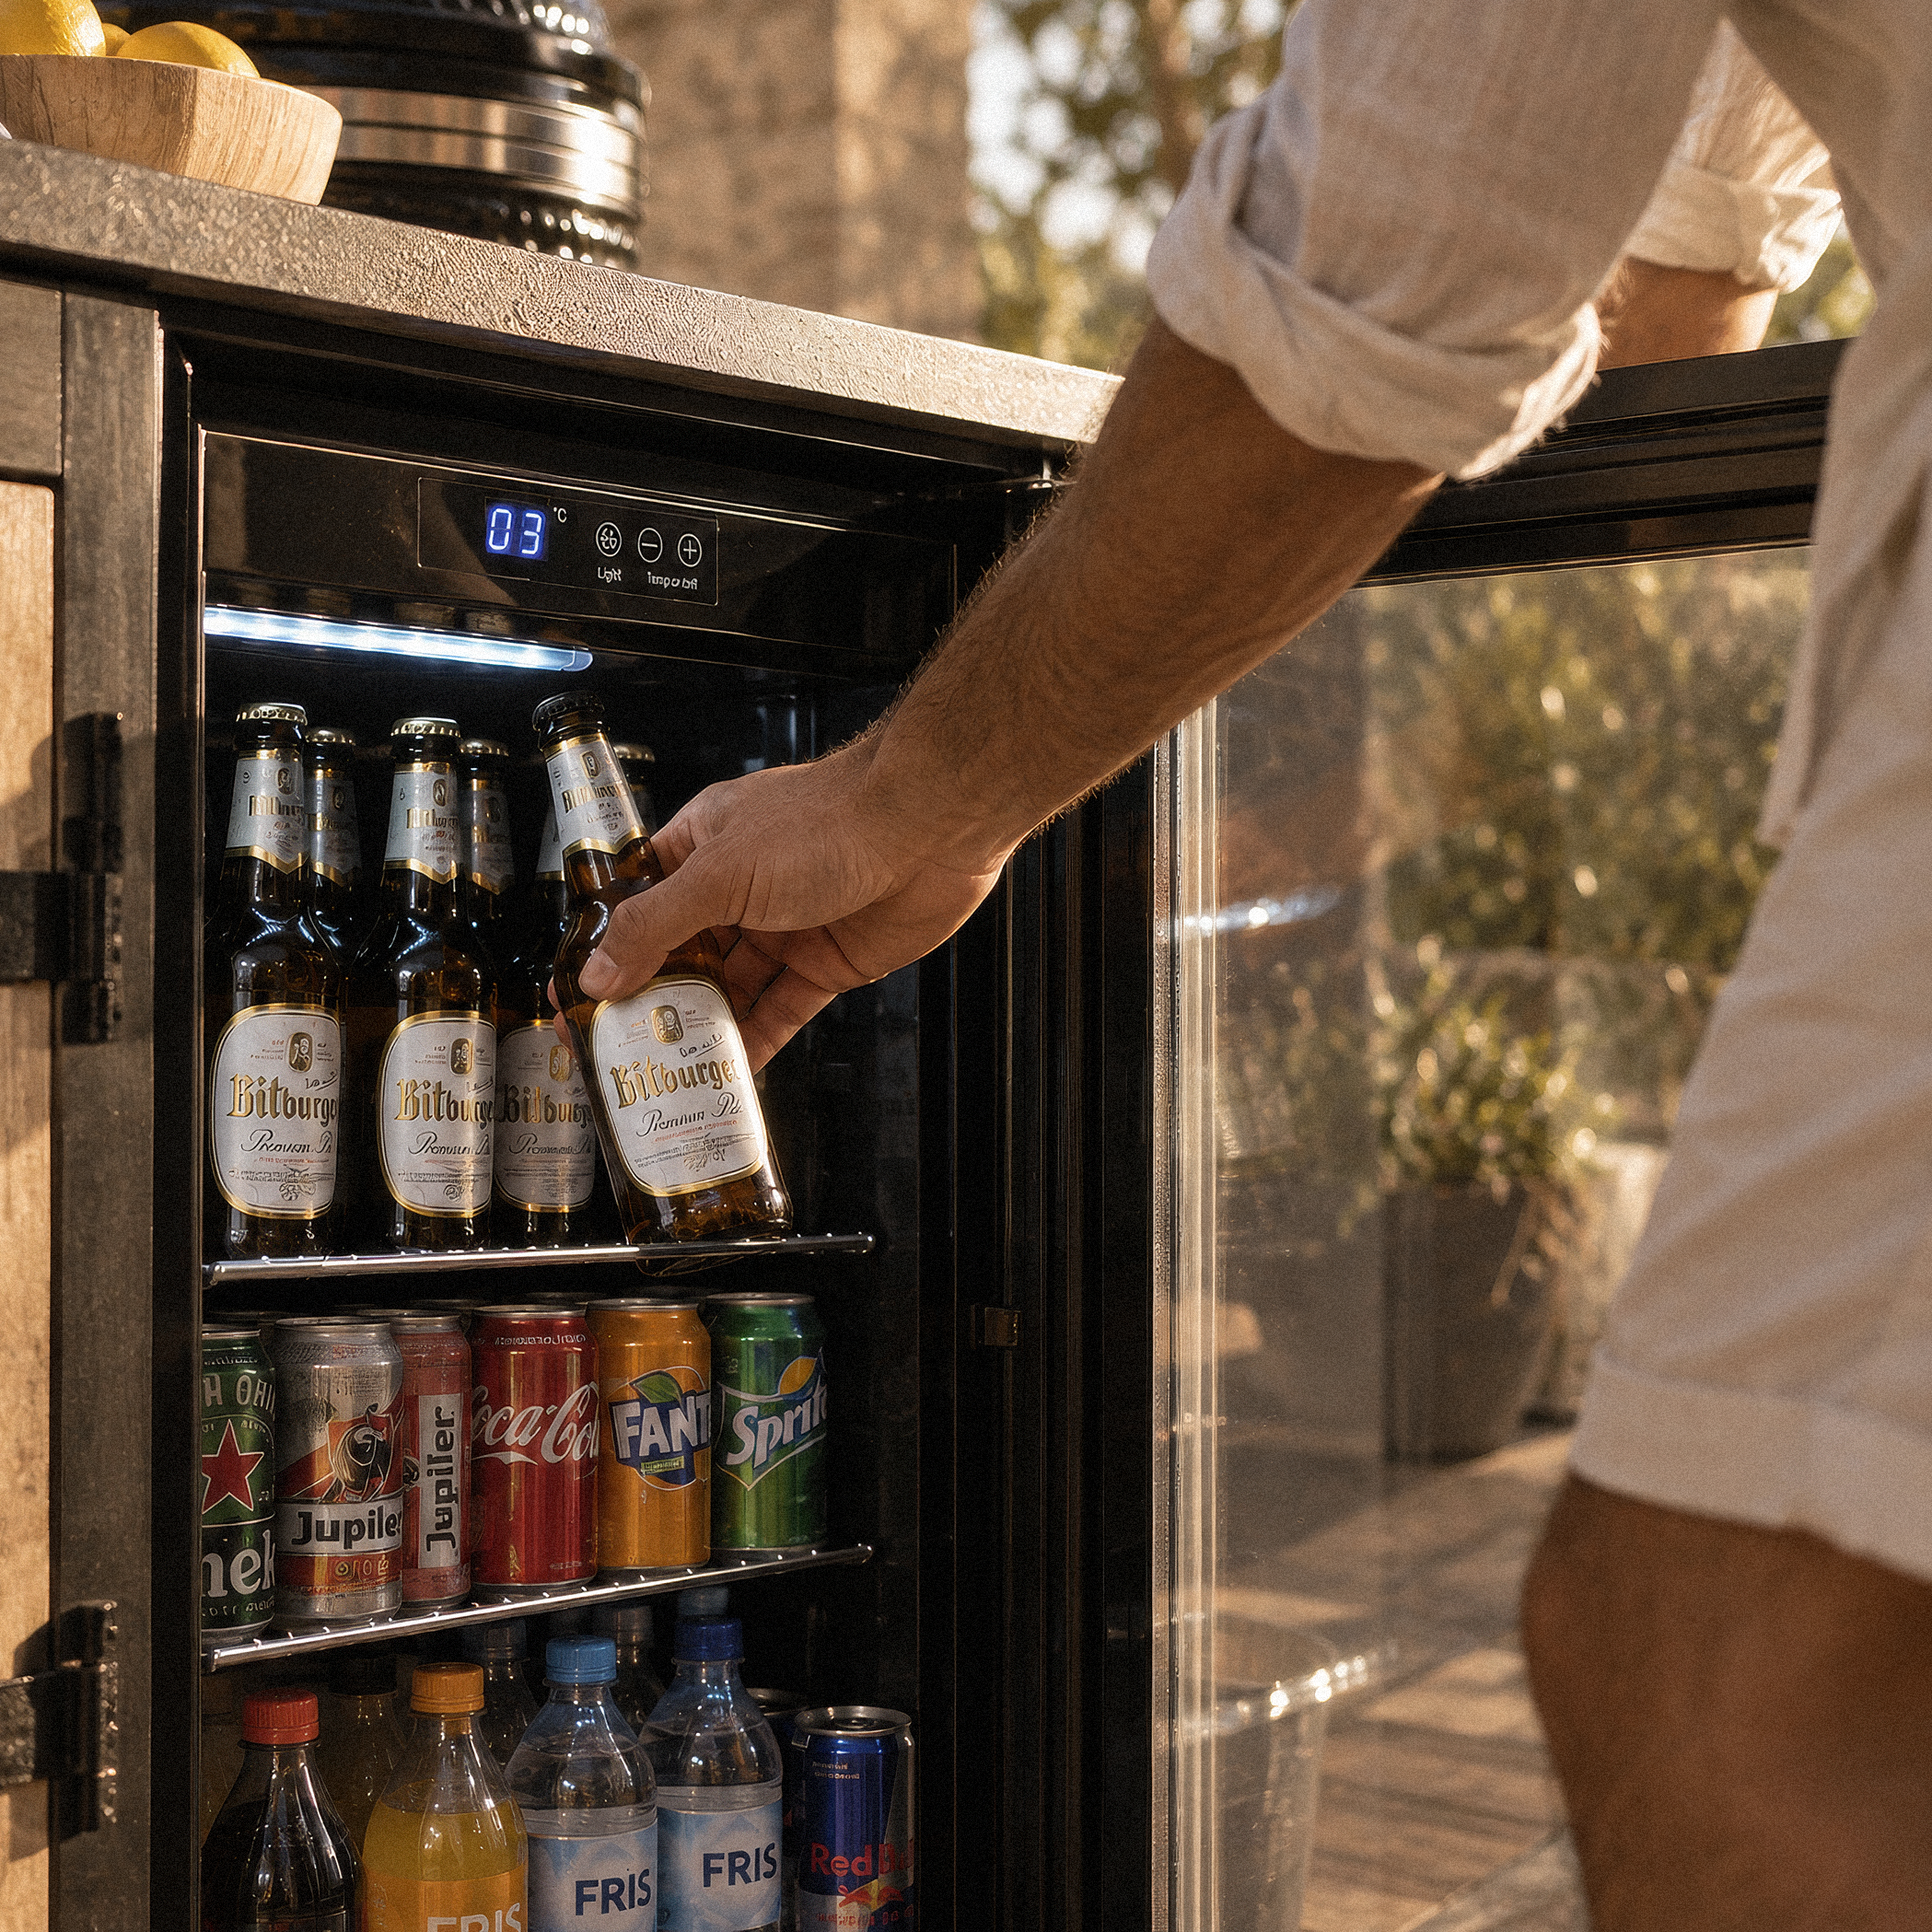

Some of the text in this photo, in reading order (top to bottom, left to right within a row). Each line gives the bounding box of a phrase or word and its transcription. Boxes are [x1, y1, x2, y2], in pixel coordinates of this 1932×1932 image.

[490, 507, 542, 555] 03
[471, 1381, 599, 1464] oca-Col
[425, 1405, 459, 1552] Jupiler
[702, 1842, 778, 1889] FRIS
[810, 1842, 873, 1878] Red
[575, 1868, 652, 1916] FRIS
